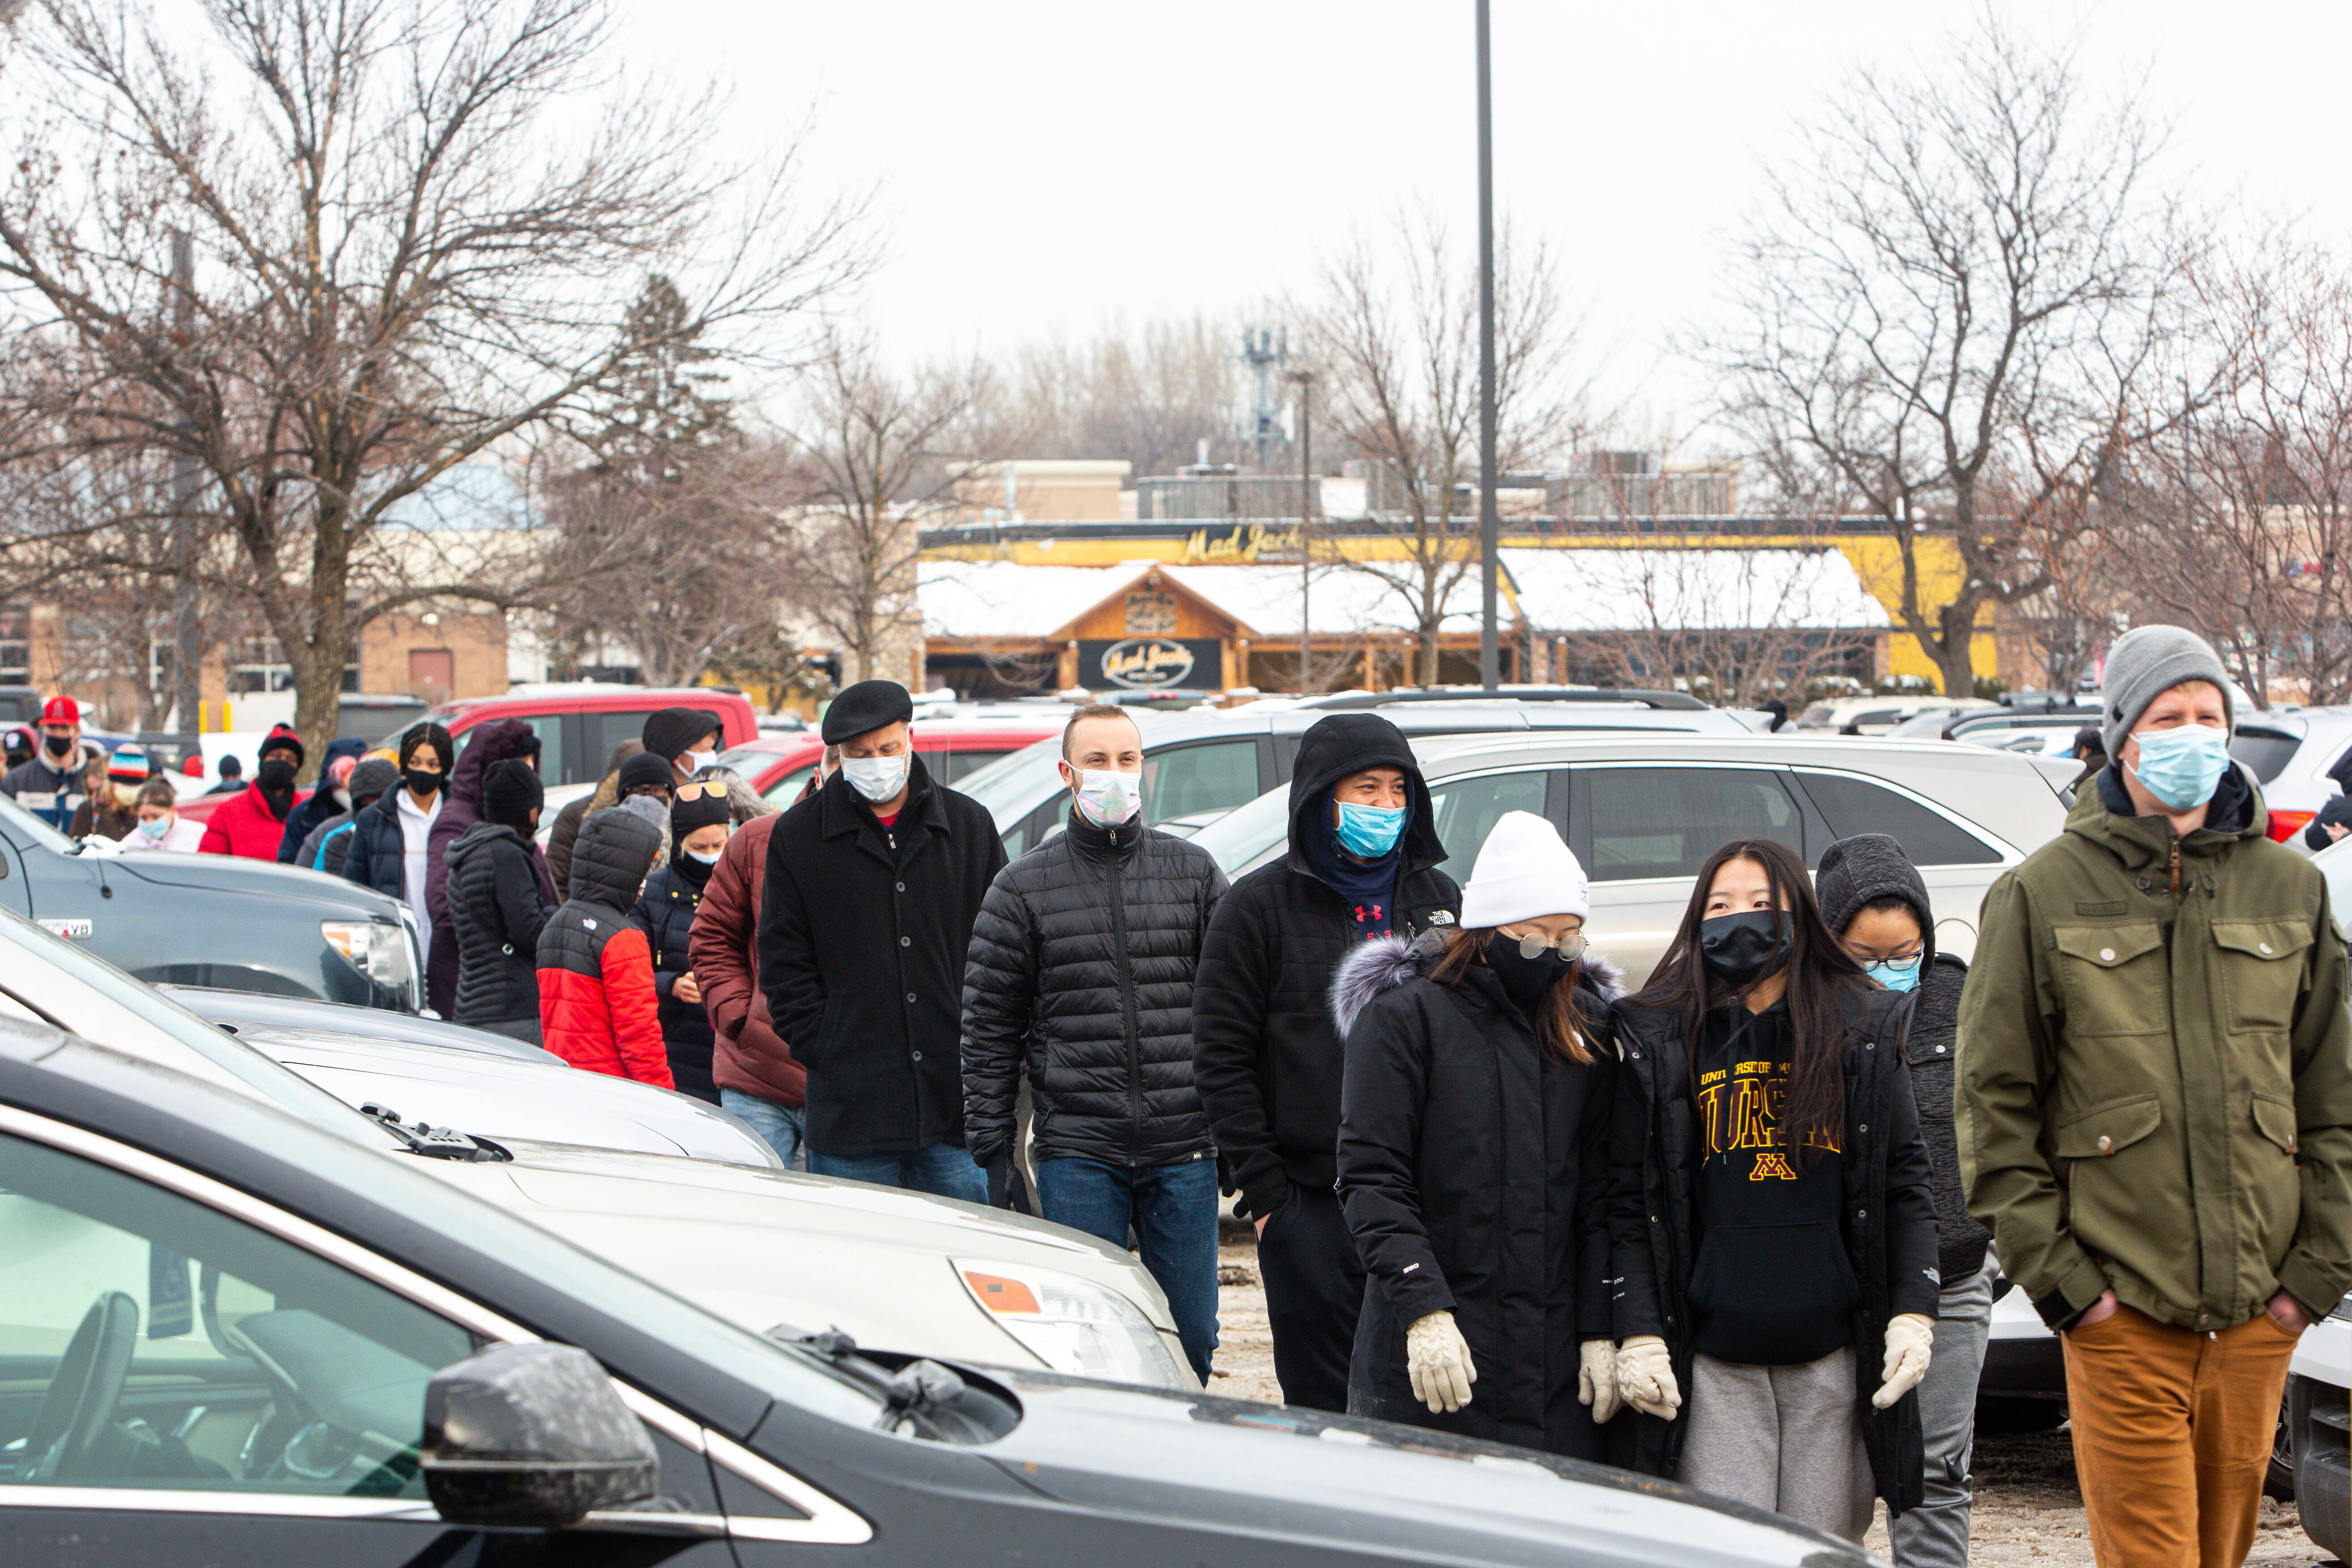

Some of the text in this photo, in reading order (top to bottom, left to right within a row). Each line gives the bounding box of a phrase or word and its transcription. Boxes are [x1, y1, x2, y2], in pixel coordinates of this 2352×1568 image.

[1178, 525, 1243, 565] Mad
[71, 924, 88, 934] V8
[1758, 1062, 1771, 1073] OF
